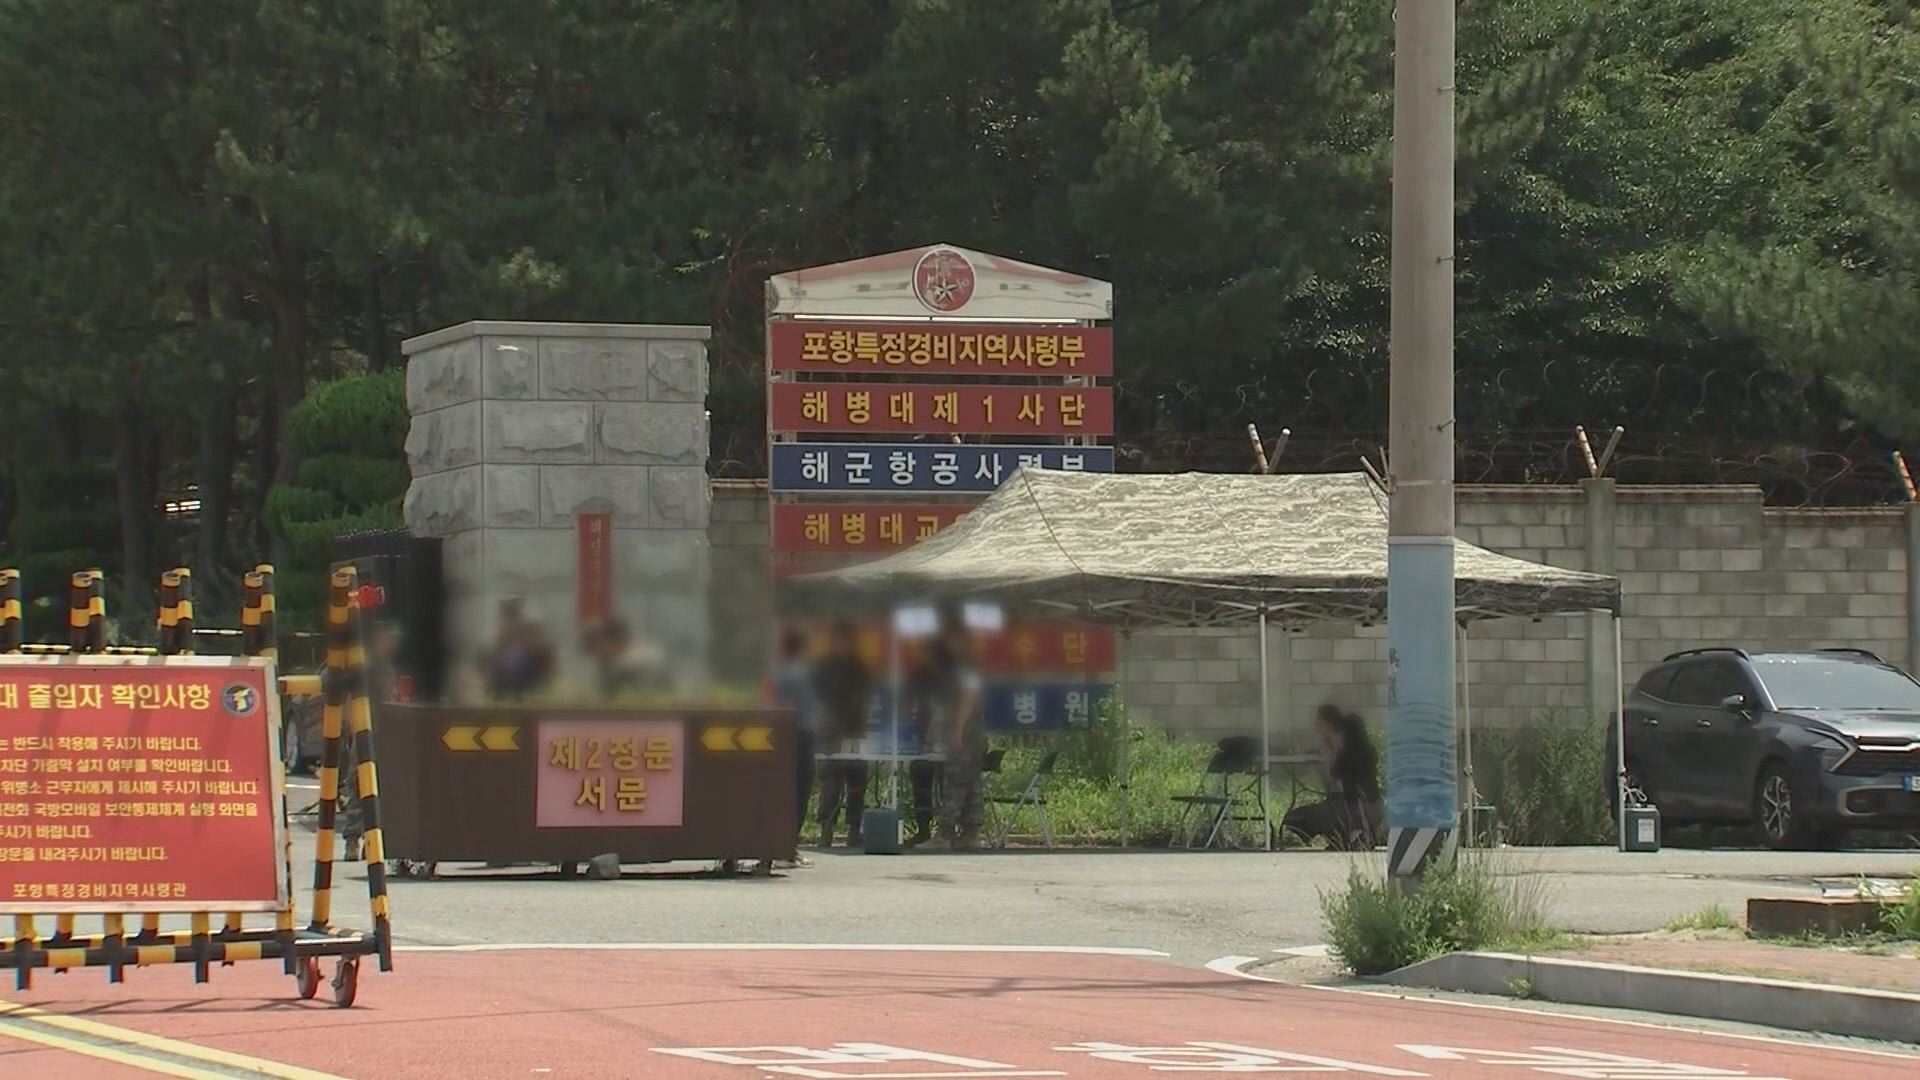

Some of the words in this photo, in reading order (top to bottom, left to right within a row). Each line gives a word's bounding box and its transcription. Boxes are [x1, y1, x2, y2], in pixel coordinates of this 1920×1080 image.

[803, 331, 1085, 366] 포항특정경비지역사령부
[804, 513, 968, 545] 해병대교
[29, 684, 103, 708] 출입자
[112, 684, 210, 709] 확인사항
[13, 737, 53, 750] 반드시
[102, 737, 141, 750] 주시기
[146, 737, 201, 751] 바랍니다.
[551, 736, 673, 770] 제2정문
[47, 781, 113, 794] 근무자에게
[162, 781, 200, 794] 주시기
[205, 781, 259, 795] 바랍니다.
[576, 777, 647, 811] 서문
[0, 803, 29, 816] 전화
[36, 825, 92, 839] 바랍니다.
[40, 848, 106, 861] 내려주시기
[111, 847, 167, 861] 바랍니다.
[14, 883, 186, 898] 포항특정경비지역사령관
